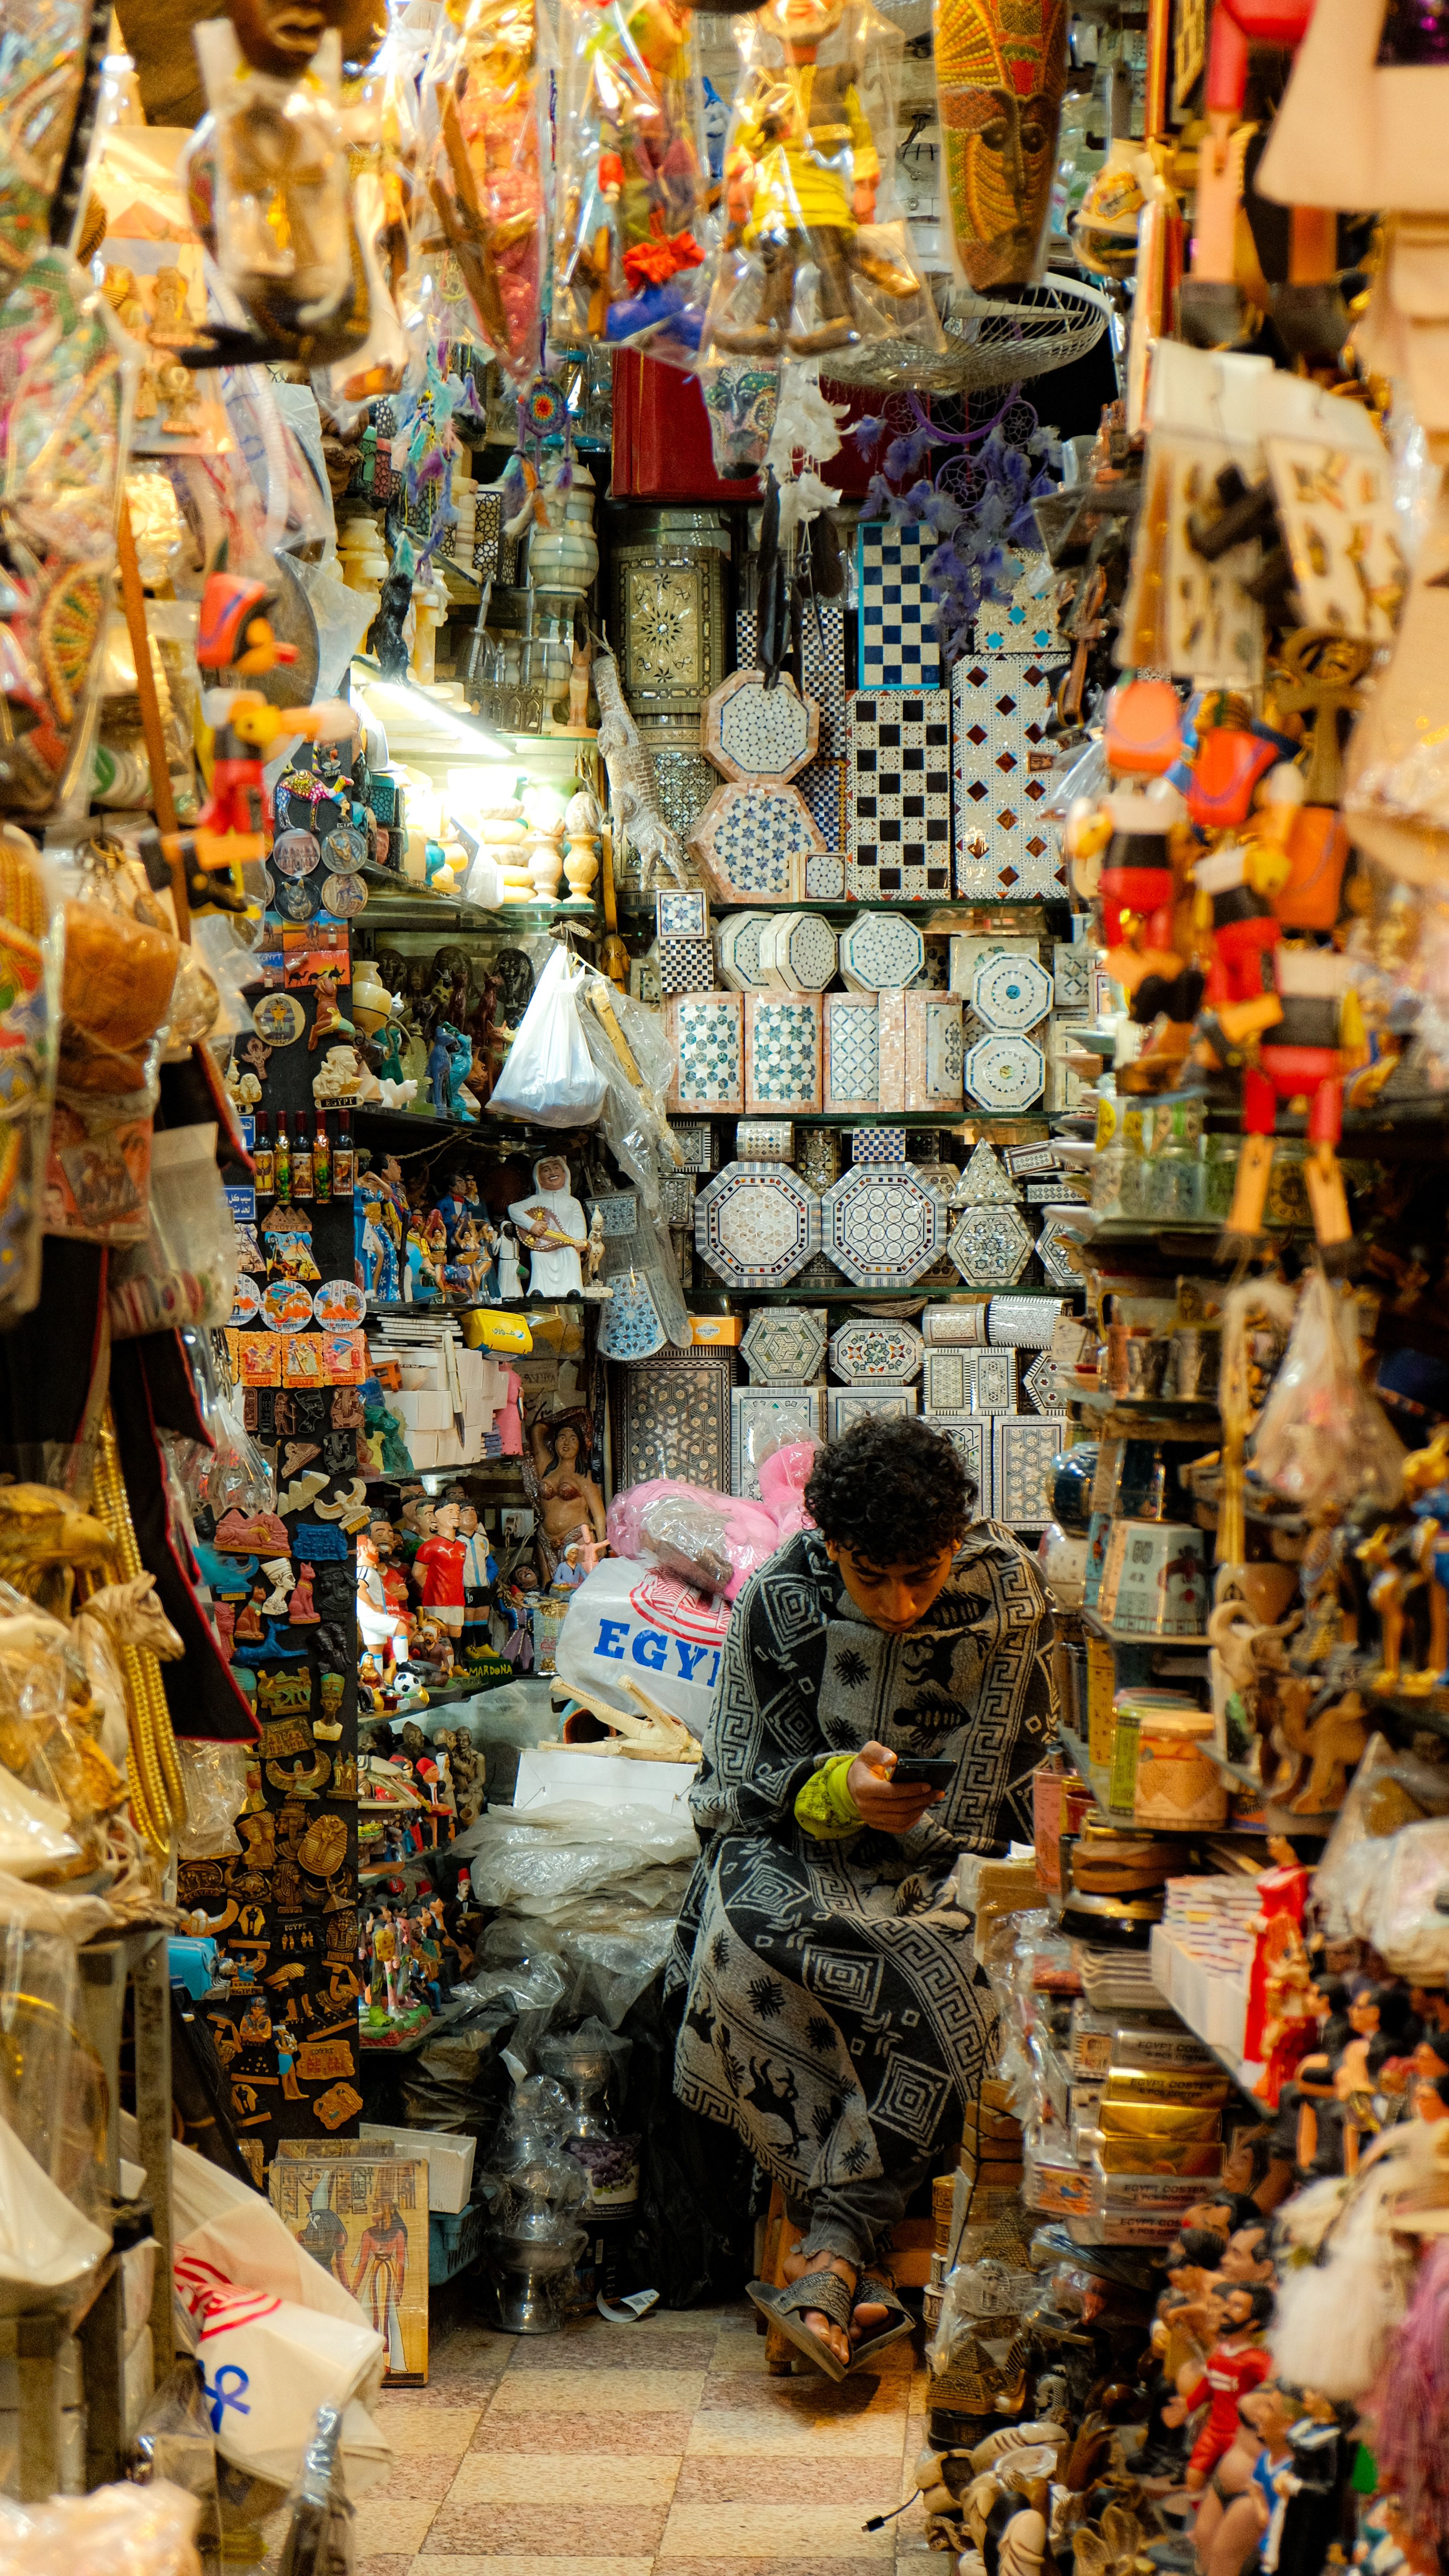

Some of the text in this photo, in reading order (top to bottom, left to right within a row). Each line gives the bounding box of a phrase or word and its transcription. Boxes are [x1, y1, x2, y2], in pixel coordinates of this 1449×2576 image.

[326, 1098, 354, 1106] EGYPT
[470, 1664, 512, 1677] MARDONA
[1137, 2041, 1172, 2050] EGYPT
[1130, 2079, 1214, 2092] EGYPT COSTER
[1124, 2184, 1206, 2194] EGYPT COSTER
[1158, 2219, 1181, 2228] COS
